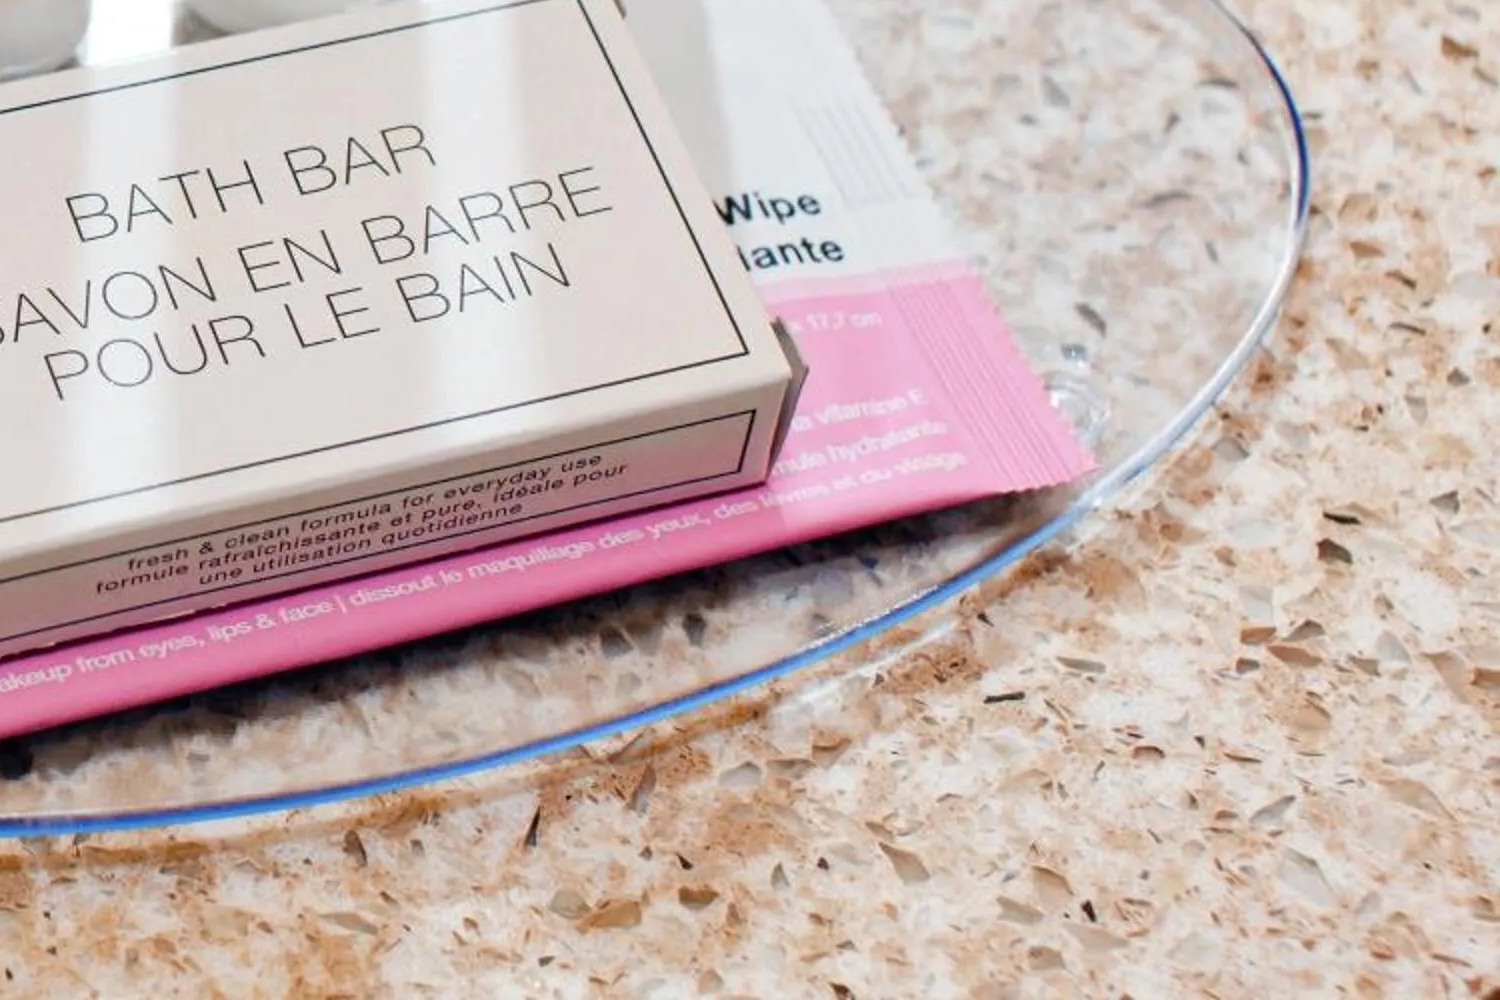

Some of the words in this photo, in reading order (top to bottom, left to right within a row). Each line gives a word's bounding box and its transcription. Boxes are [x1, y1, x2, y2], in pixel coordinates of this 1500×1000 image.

[65, 159, 264, 243] BATH
[283, 123, 437, 195] BAR
[236, 229, 342, 294] EN
[360, 166, 613, 265] BARRE
[711, 190, 821, 225] Wipe
[43, 314, 265, 400] POUR
[284, 287, 381, 349] LE
[396, 242, 571, 323] BAIN
[96, 563, 189, 595] formule
[390, 511, 412, 527] et
[493, 476, 565, 504] idéale
[572, 463, 629, 488] pour
[127, 549, 189, 572] fresh
[198, 540, 214, 555] &
[224, 523, 290, 549] clean
[301, 501, 392, 534] formula
[402, 492, 435, 510] for
[443, 462, 551, 500] everyday
[560, 454, 602, 474] use
[199, 567, 243, 586] une
[252, 537, 372, 573] utilisation
[381, 502, 523, 547] quotidienne
[75, 647, 135, 674] from
[139, 633, 205, 659] eyes,
[207, 620, 252, 644] lips
[255, 613, 277, 630] &
[279, 598, 333, 624] face
[350, 573, 437, 605] dissout
[440, 570, 463, 589] le
[467, 539, 596, 580] maquillage
[599, 525, 645, 548] des
[714, 498, 758, 520] des
